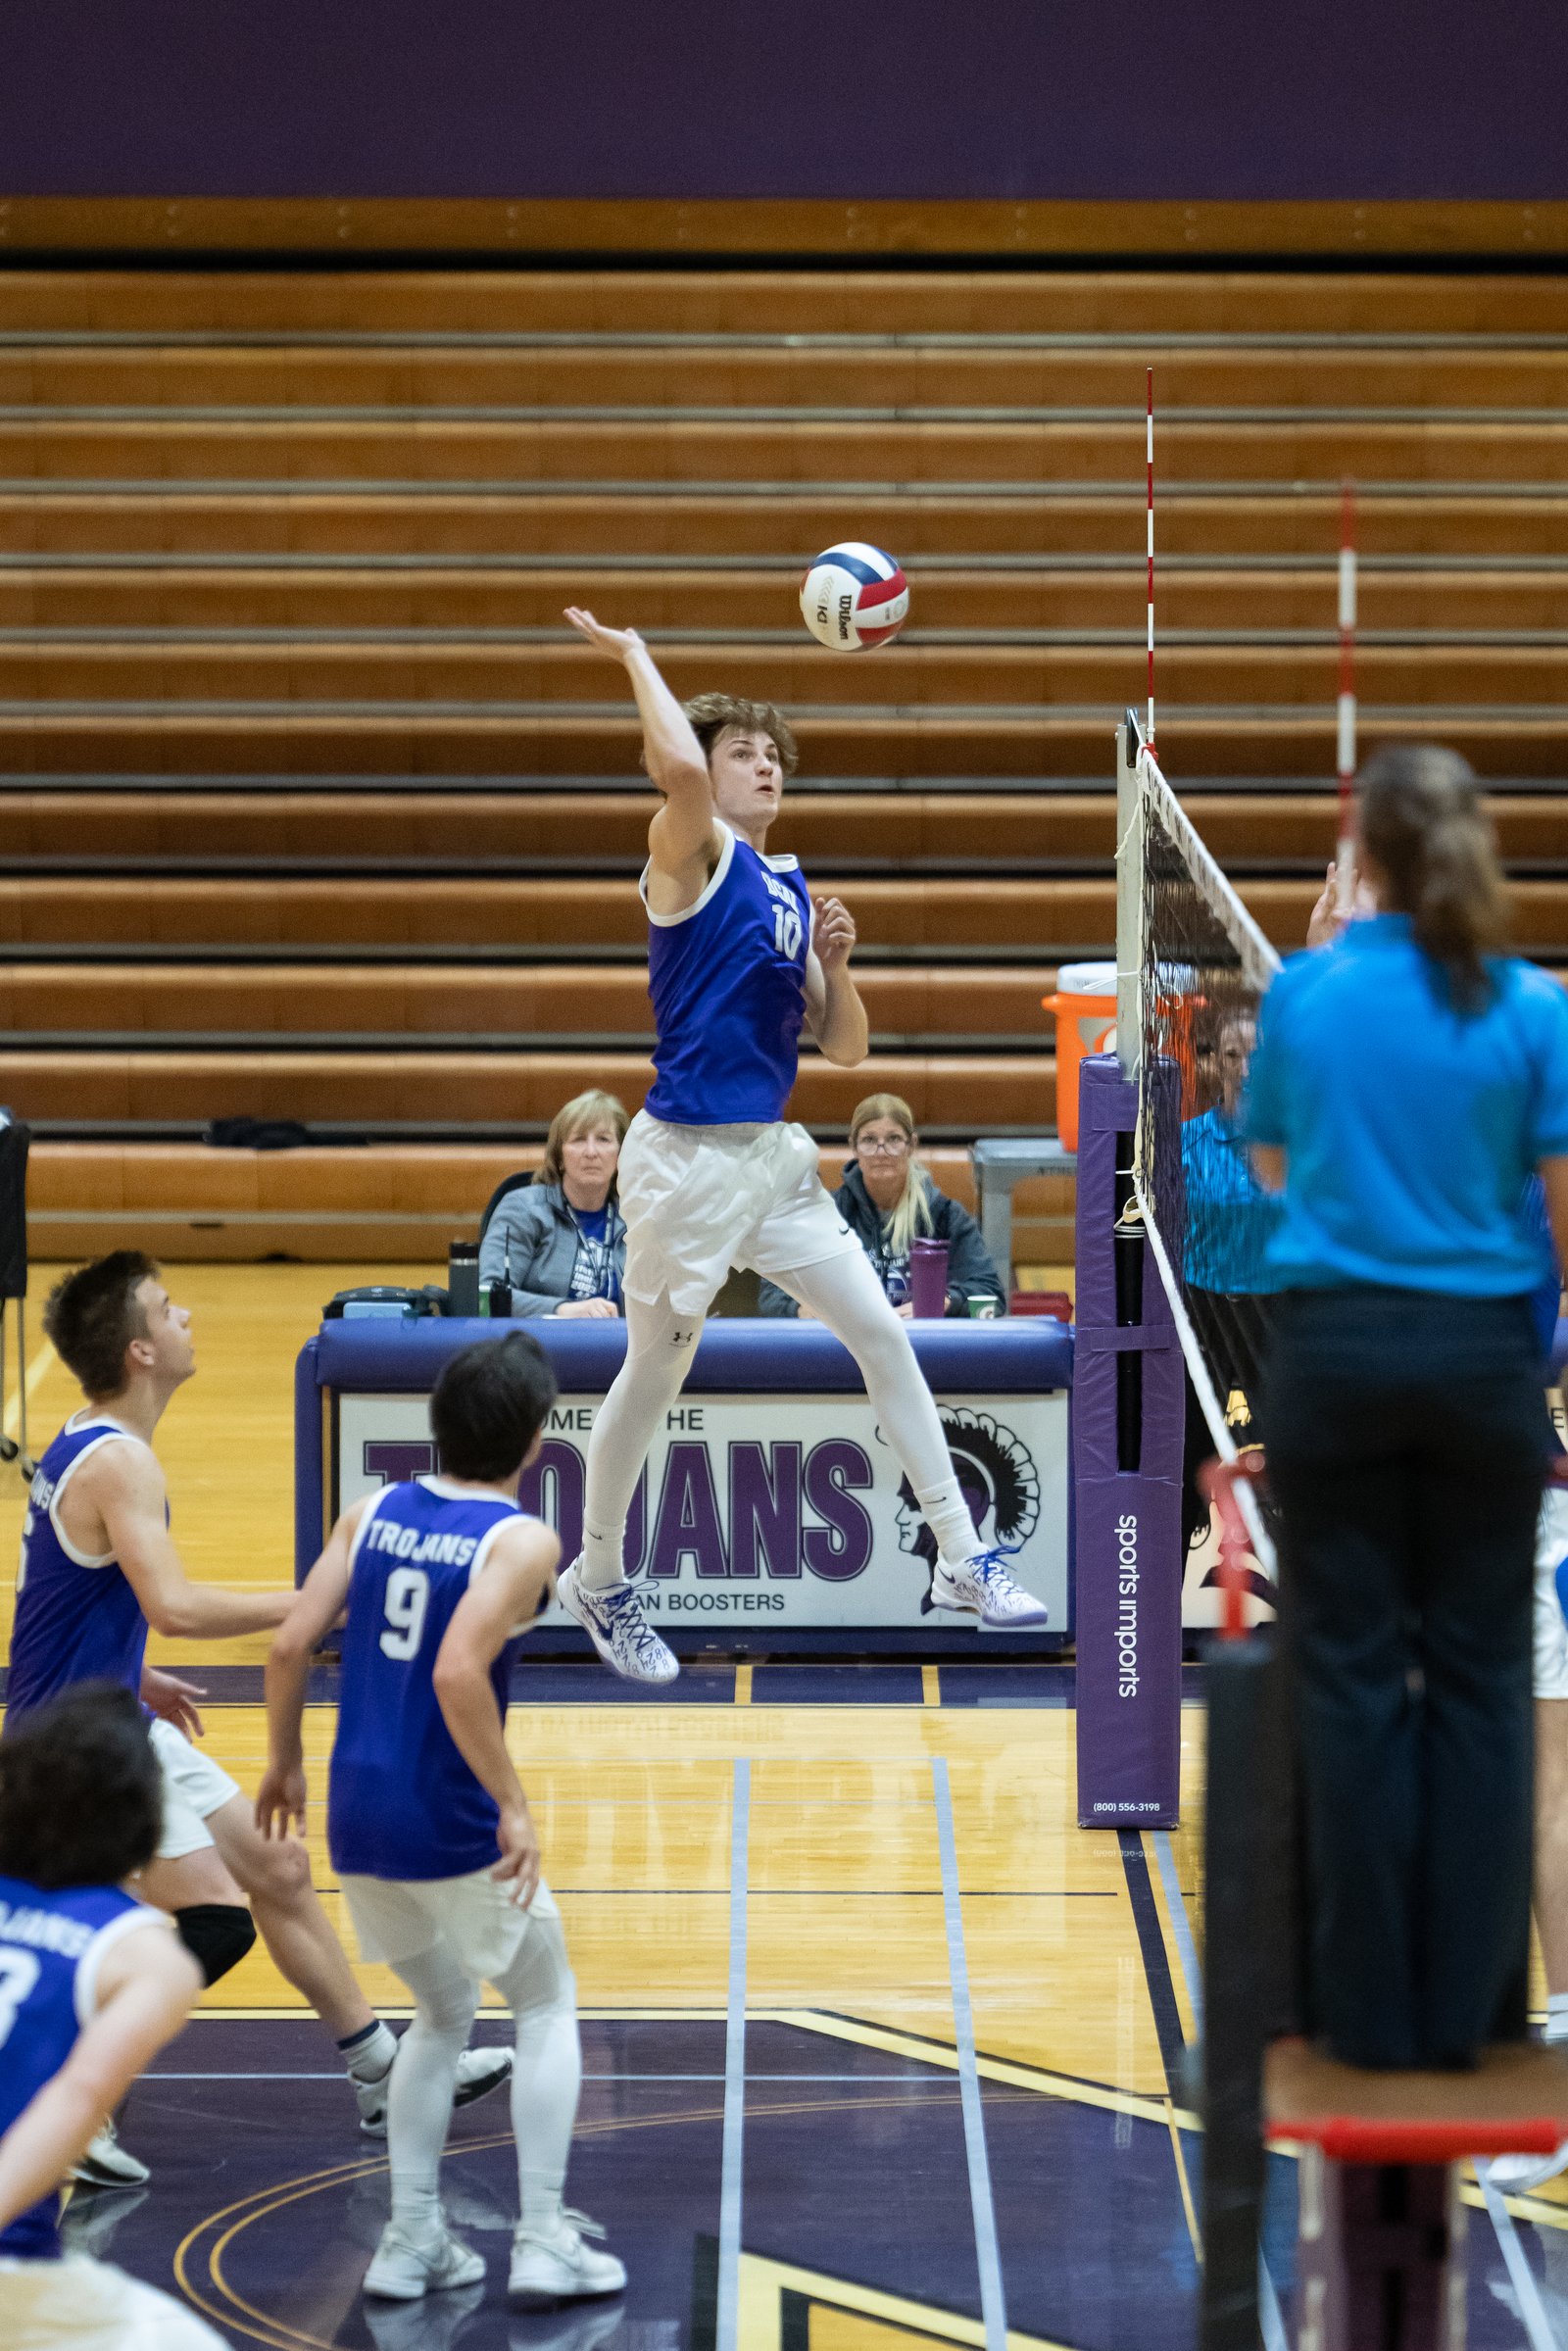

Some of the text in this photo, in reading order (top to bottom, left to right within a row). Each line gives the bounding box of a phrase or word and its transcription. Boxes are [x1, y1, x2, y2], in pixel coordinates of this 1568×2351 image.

[839, 595, 852, 640] Wilson
[772, 904, 802, 960] 10
[542, 1409, 704, 1431] ME HE
[366, 1519, 479, 1567] TROJANS
[1114, 1514, 1141, 1594] sports
[379, 1566, 430, 1662] 9
[668, 1594, 785, 1611] BOOSTERS
[1093, 1802, 1160, 1813] (800) 556-3198
